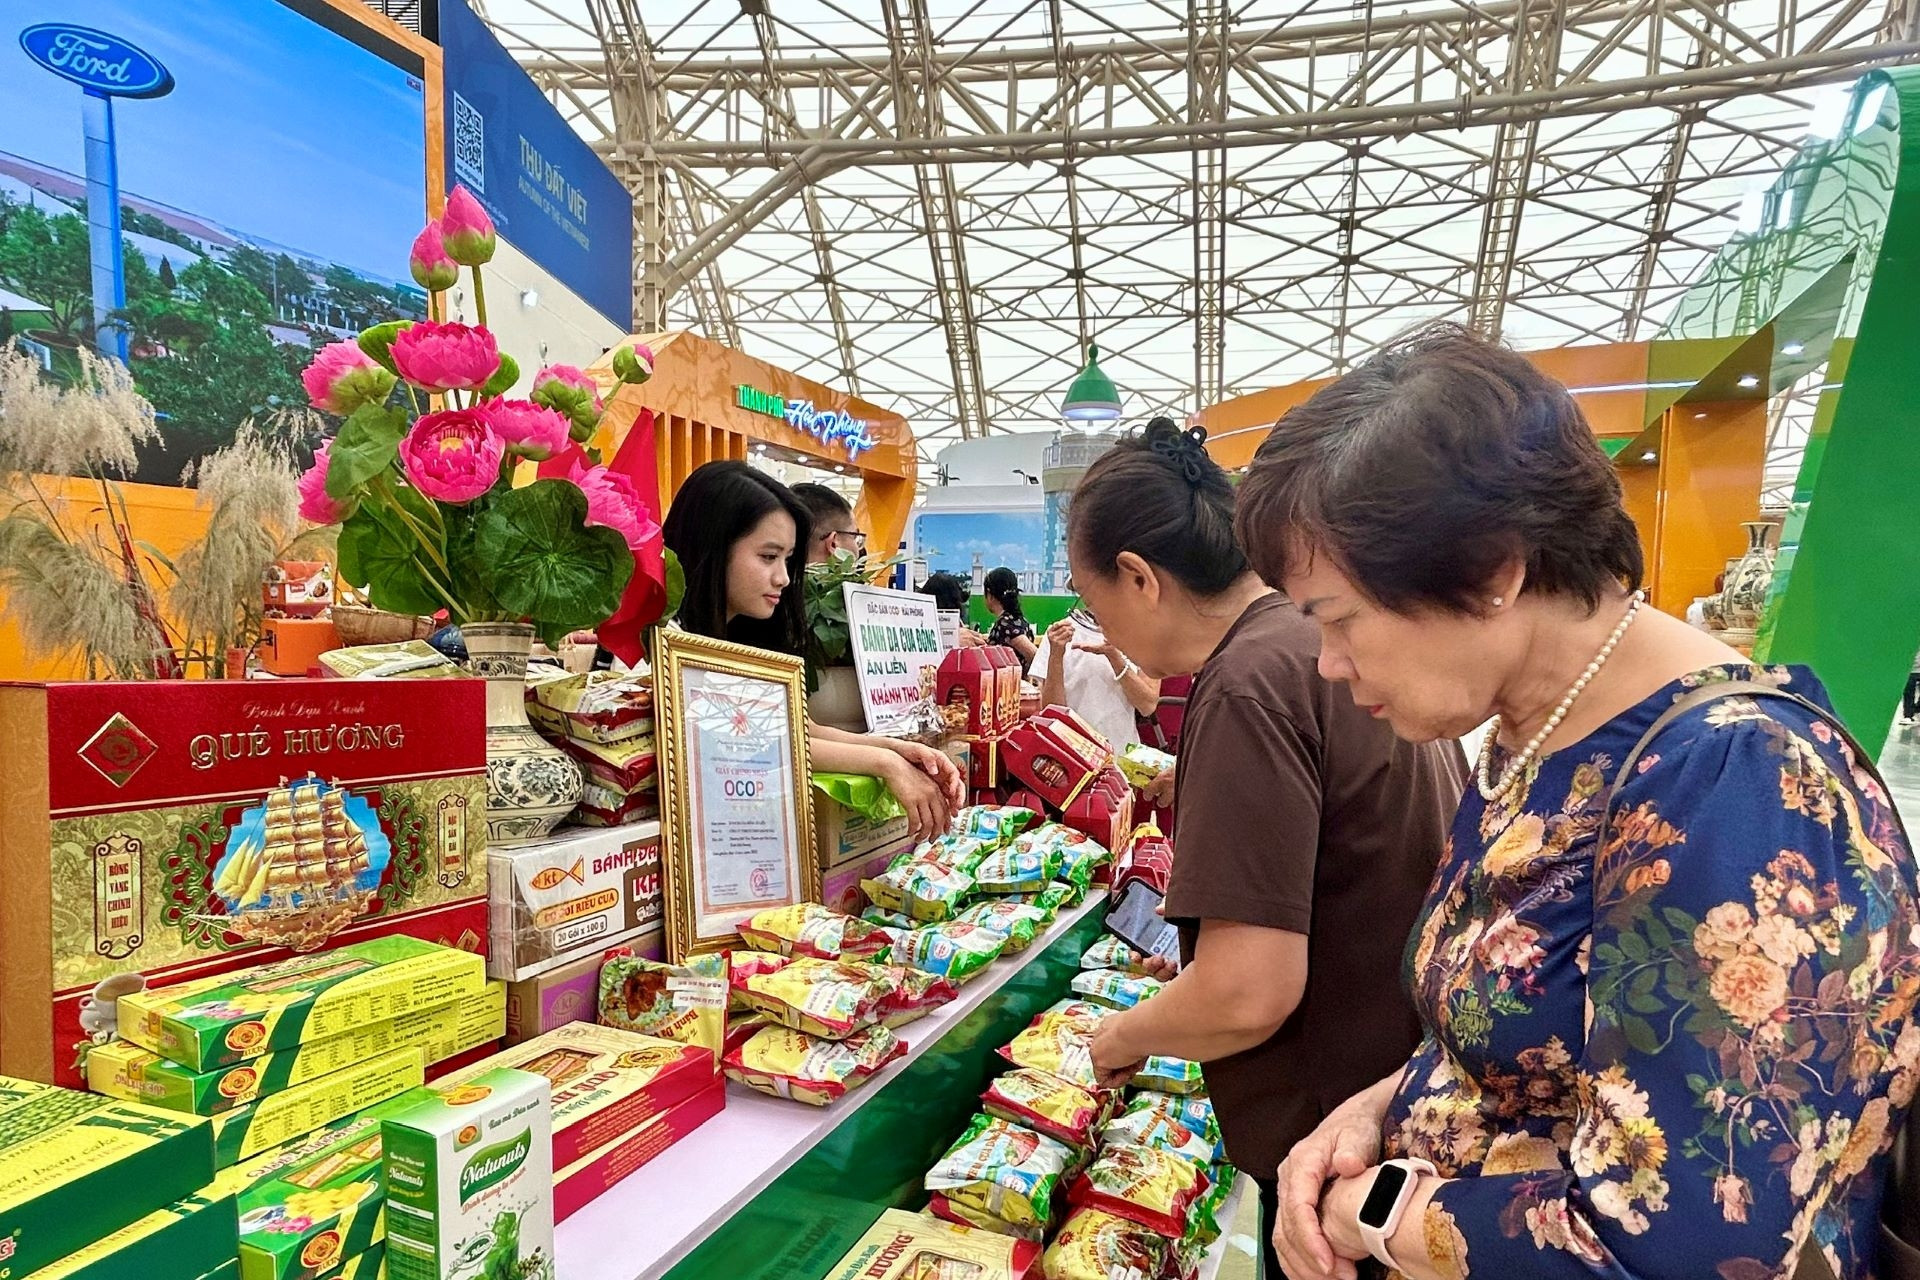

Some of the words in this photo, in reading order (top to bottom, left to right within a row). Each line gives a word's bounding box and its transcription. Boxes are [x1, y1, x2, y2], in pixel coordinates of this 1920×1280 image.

[48, 33, 131, 83] Ford
[519, 134, 543, 183] THU
[860, 619, 887, 652] BÁNH
[900, 627, 917, 652] CUA
[870, 682, 903, 706] KHÁNH
[189, 724, 272, 770] QUÊ
[283, 723, 405, 757] HƯƠNG
[724, 780, 764, 798] OCOP
[543, 871, 557, 886] kt
[592, 852, 634, 875] BÁNH
[598, 891, 615, 905] CUA
[557, 931, 567, 942] 20
[568, 927, 580, 938] Gói
[580, 928, 586, 936] x
[586, 922, 599, 933] 100
[33, 1154, 77, 1177] bean
[81, 1135, 120, 1155] cake
[462, 1141, 526, 1191] Natunuts
[864, 1234, 914, 1279] HƯƠNG
